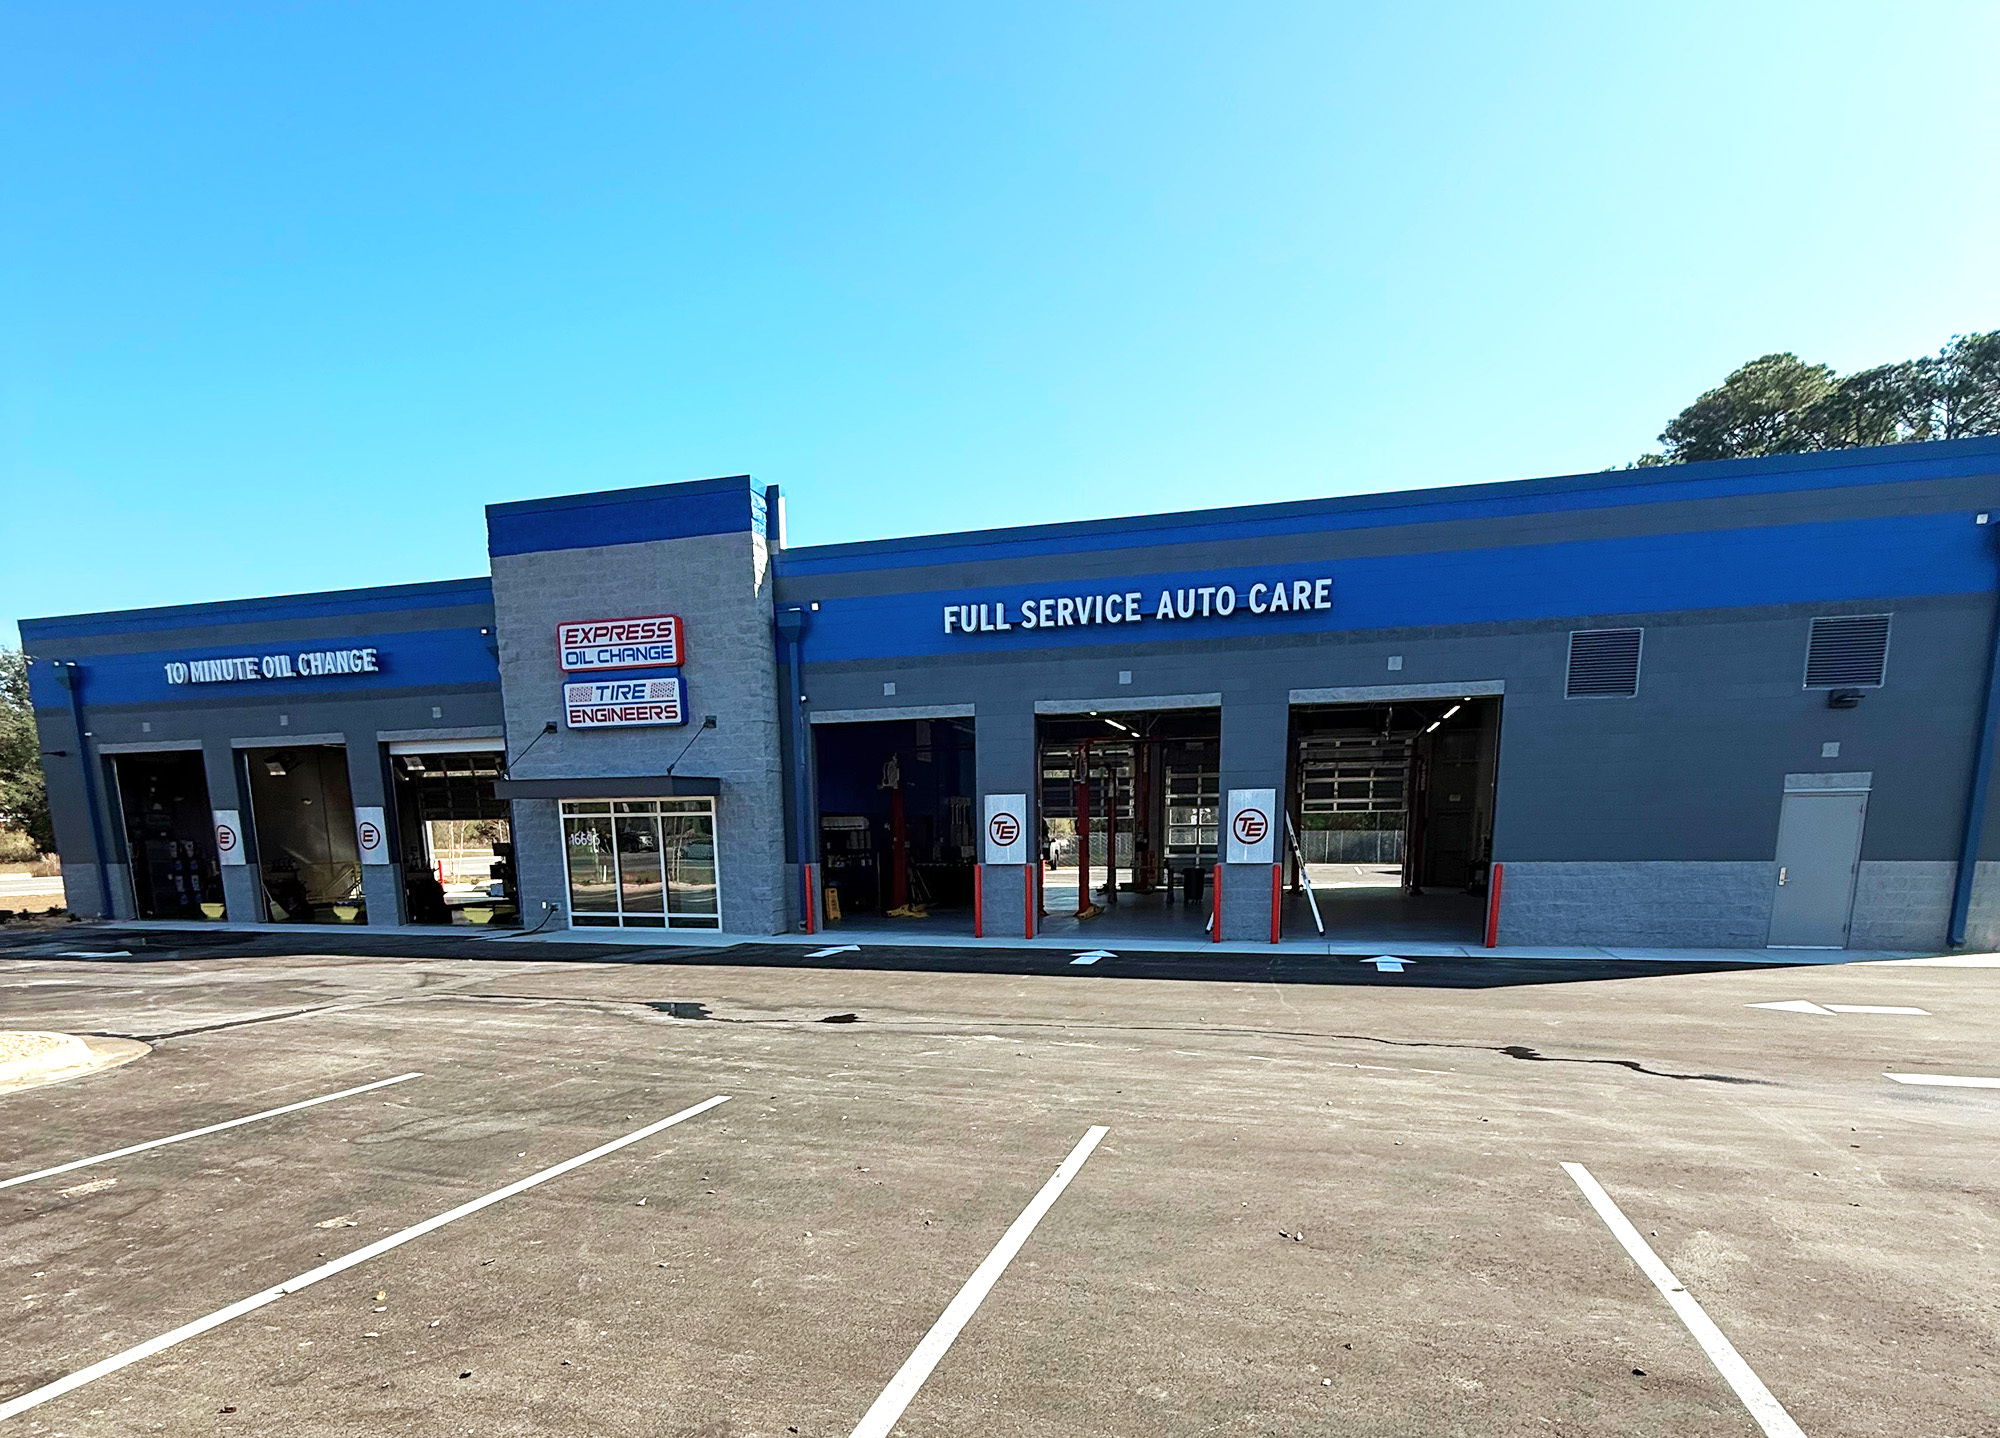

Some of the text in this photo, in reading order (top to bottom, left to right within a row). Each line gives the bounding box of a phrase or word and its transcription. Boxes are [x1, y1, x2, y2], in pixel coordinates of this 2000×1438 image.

[944, 578, 1332, 634] FULL SERVICE AUTO CARE
[565, 621, 673, 645] EXPRESS
[164, 648, 379, 685] 10 MINUTE OIL CHANGE
[565, 645, 673, 666] OIL CHANGE
[595, 683, 647, 701] TIRE
[569, 704, 678, 724] ENGINEERS
